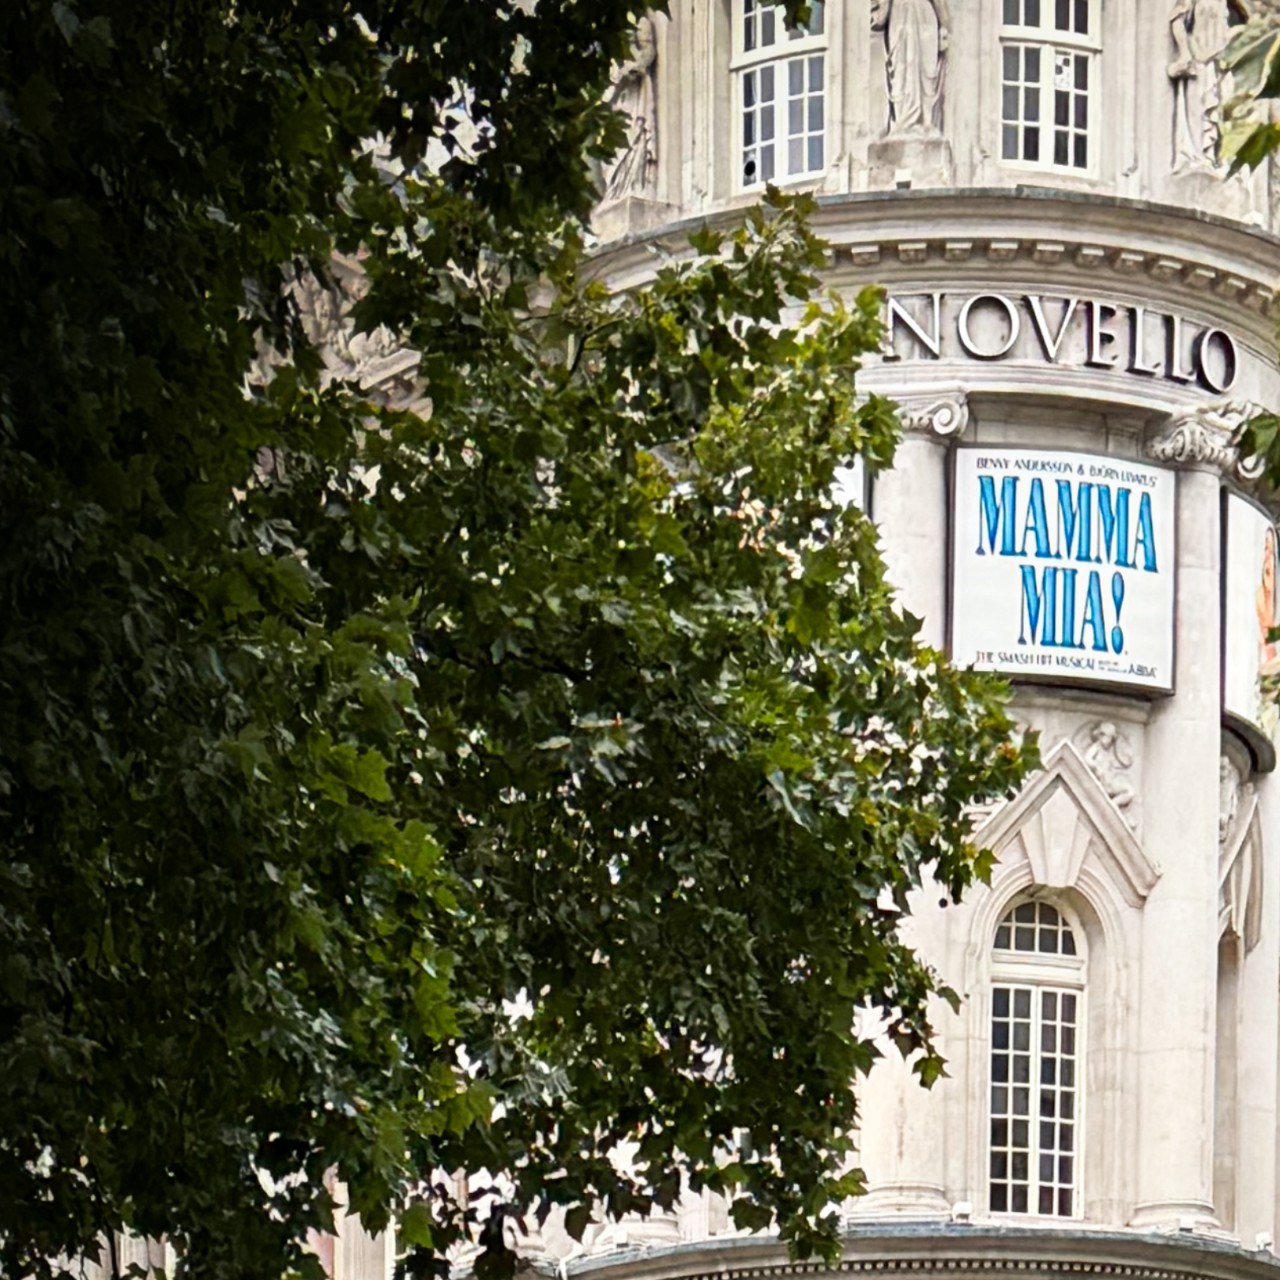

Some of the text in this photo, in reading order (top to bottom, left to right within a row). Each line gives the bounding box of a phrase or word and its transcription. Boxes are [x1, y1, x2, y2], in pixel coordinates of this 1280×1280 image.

[883, 292, 1239, 394] NOVELLO
[976, 474, 1159, 573] MAMMA
[1017, 565, 1126, 656] MIA!
